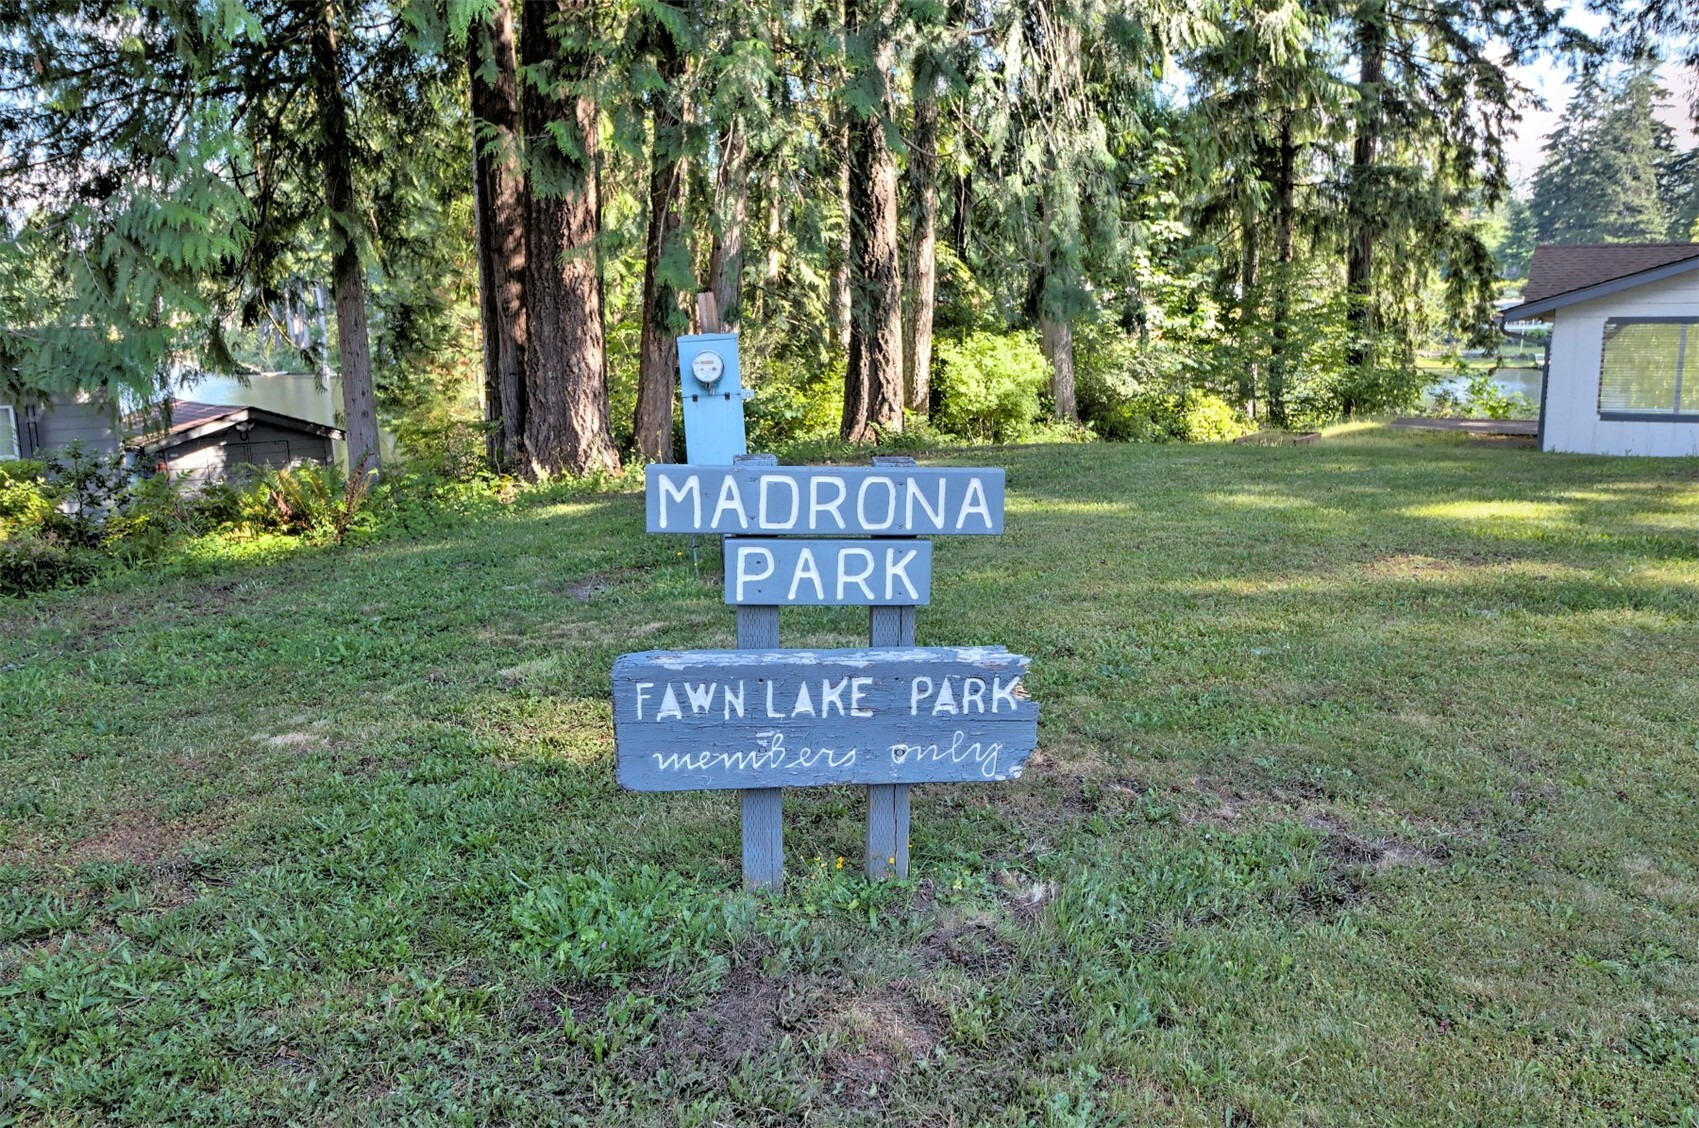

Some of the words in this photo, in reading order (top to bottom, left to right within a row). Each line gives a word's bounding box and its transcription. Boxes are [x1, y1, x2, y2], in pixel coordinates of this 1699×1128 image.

[658, 475, 993, 530] MADRONA
[736, 547, 919, 601] PARK
[636, 682, 745, 722] FAWN
[766, 677, 874, 719] LAKE
[910, 676, 1020, 717] PARK
[653, 733, 857, 770] members
[888, 731, 1003, 777] only
